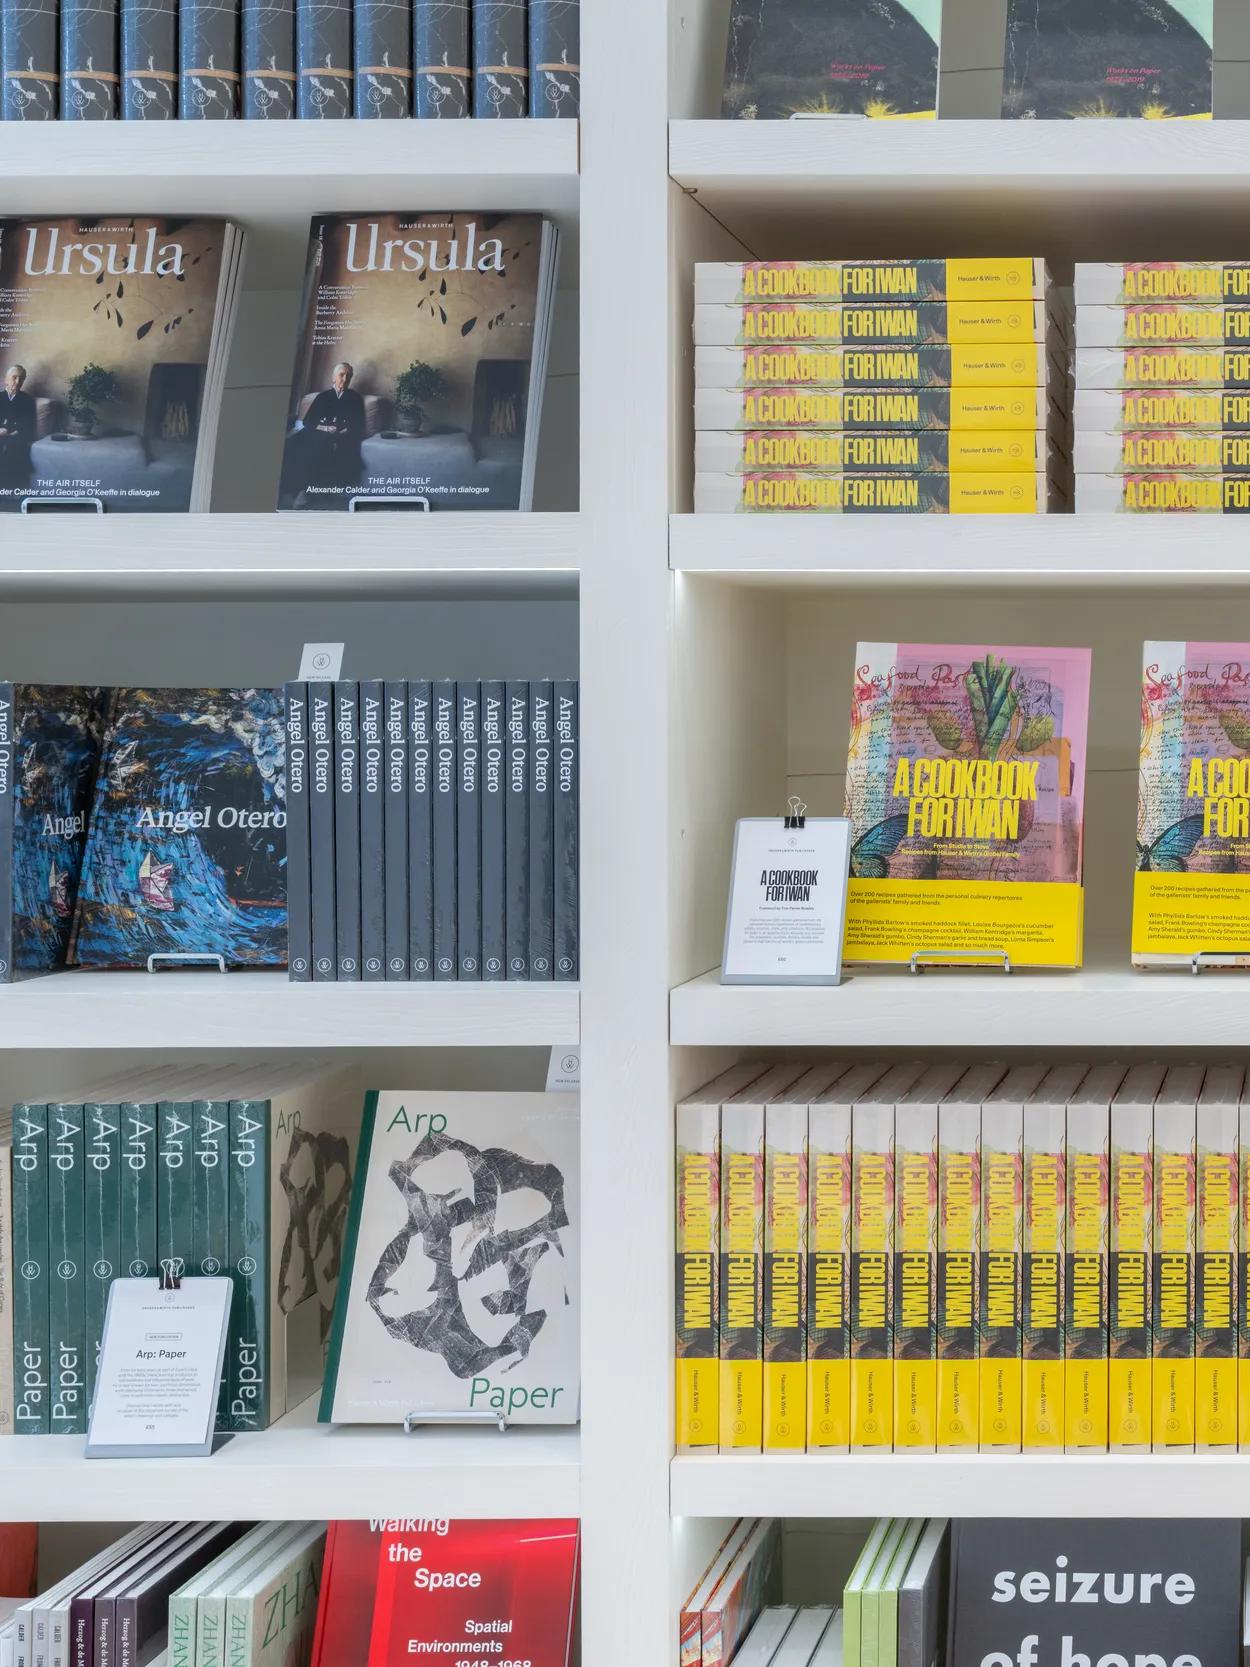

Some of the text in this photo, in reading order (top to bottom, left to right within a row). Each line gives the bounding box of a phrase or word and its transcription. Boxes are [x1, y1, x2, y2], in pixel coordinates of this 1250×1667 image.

[24, 227, 185, 276] Ursula
[346, 222, 506, 272] Ursula
[744, 268, 754, 295] A
[757, 268, 842, 295] COOKBOOK
[843, 268, 875, 294] FOR
[876, 267, 918, 294] IWAN
[14, 488, 39, 496] Calder
[40, 488, 54, 496] and
[56, 488, 85, 497] Georgia
[119, 488, 127, 496] in
[127, 488, 160, 498] dialogue
[306, 486, 344, 494] Alexander
[345, 486, 370, 494] Calder
[371, 486, 385, 494] and
[387, 486, 416, 495] Georgia
[449, 486, 457, 494] in
[457, 486, 489, 495] dialogue
[368, 477, 431, 485] THE AIR ITSELF
[288, 697, 305, 793] Angel Otero
[556, 697, 574, 793] Angel Otero
[893, 757, 1040, 800] A COOKBOOK
[1186, 757, 1206, 797] A
[42, 810, 85, 840] Angel
[136, 806, 287, 834] Angel Otero
[907, 798, 1020, 840] FOR IWAN
[1203, 797, 1250, 839] FOR
[760, 869, 819, 886] A COOKBOOK
[765, 886, 811, 901] FOR IWAN
[387, 1105, 448, 1136] Arp
[123, 1117, 153, 1171] Arp
[14, 1117, 47, 1420] Arp Paper
[231, 1114, 262, 1417] Arp Paper
[135, 1350, 187, 1360] Arp: Paper
[469, 1377, 564, 1415] Paper
[369, 1518, 450, 1536] Walking
[388, 1542, 422, 1562] the
[414, 1568, 481, 1592] Space
[991, 1555, 1196, 1605] seizure
[76, 1619, 86, 1642] Herzog
[464, 1619, 513, 1635] Spatial
[407, 1639, 503, 1653] Environments
